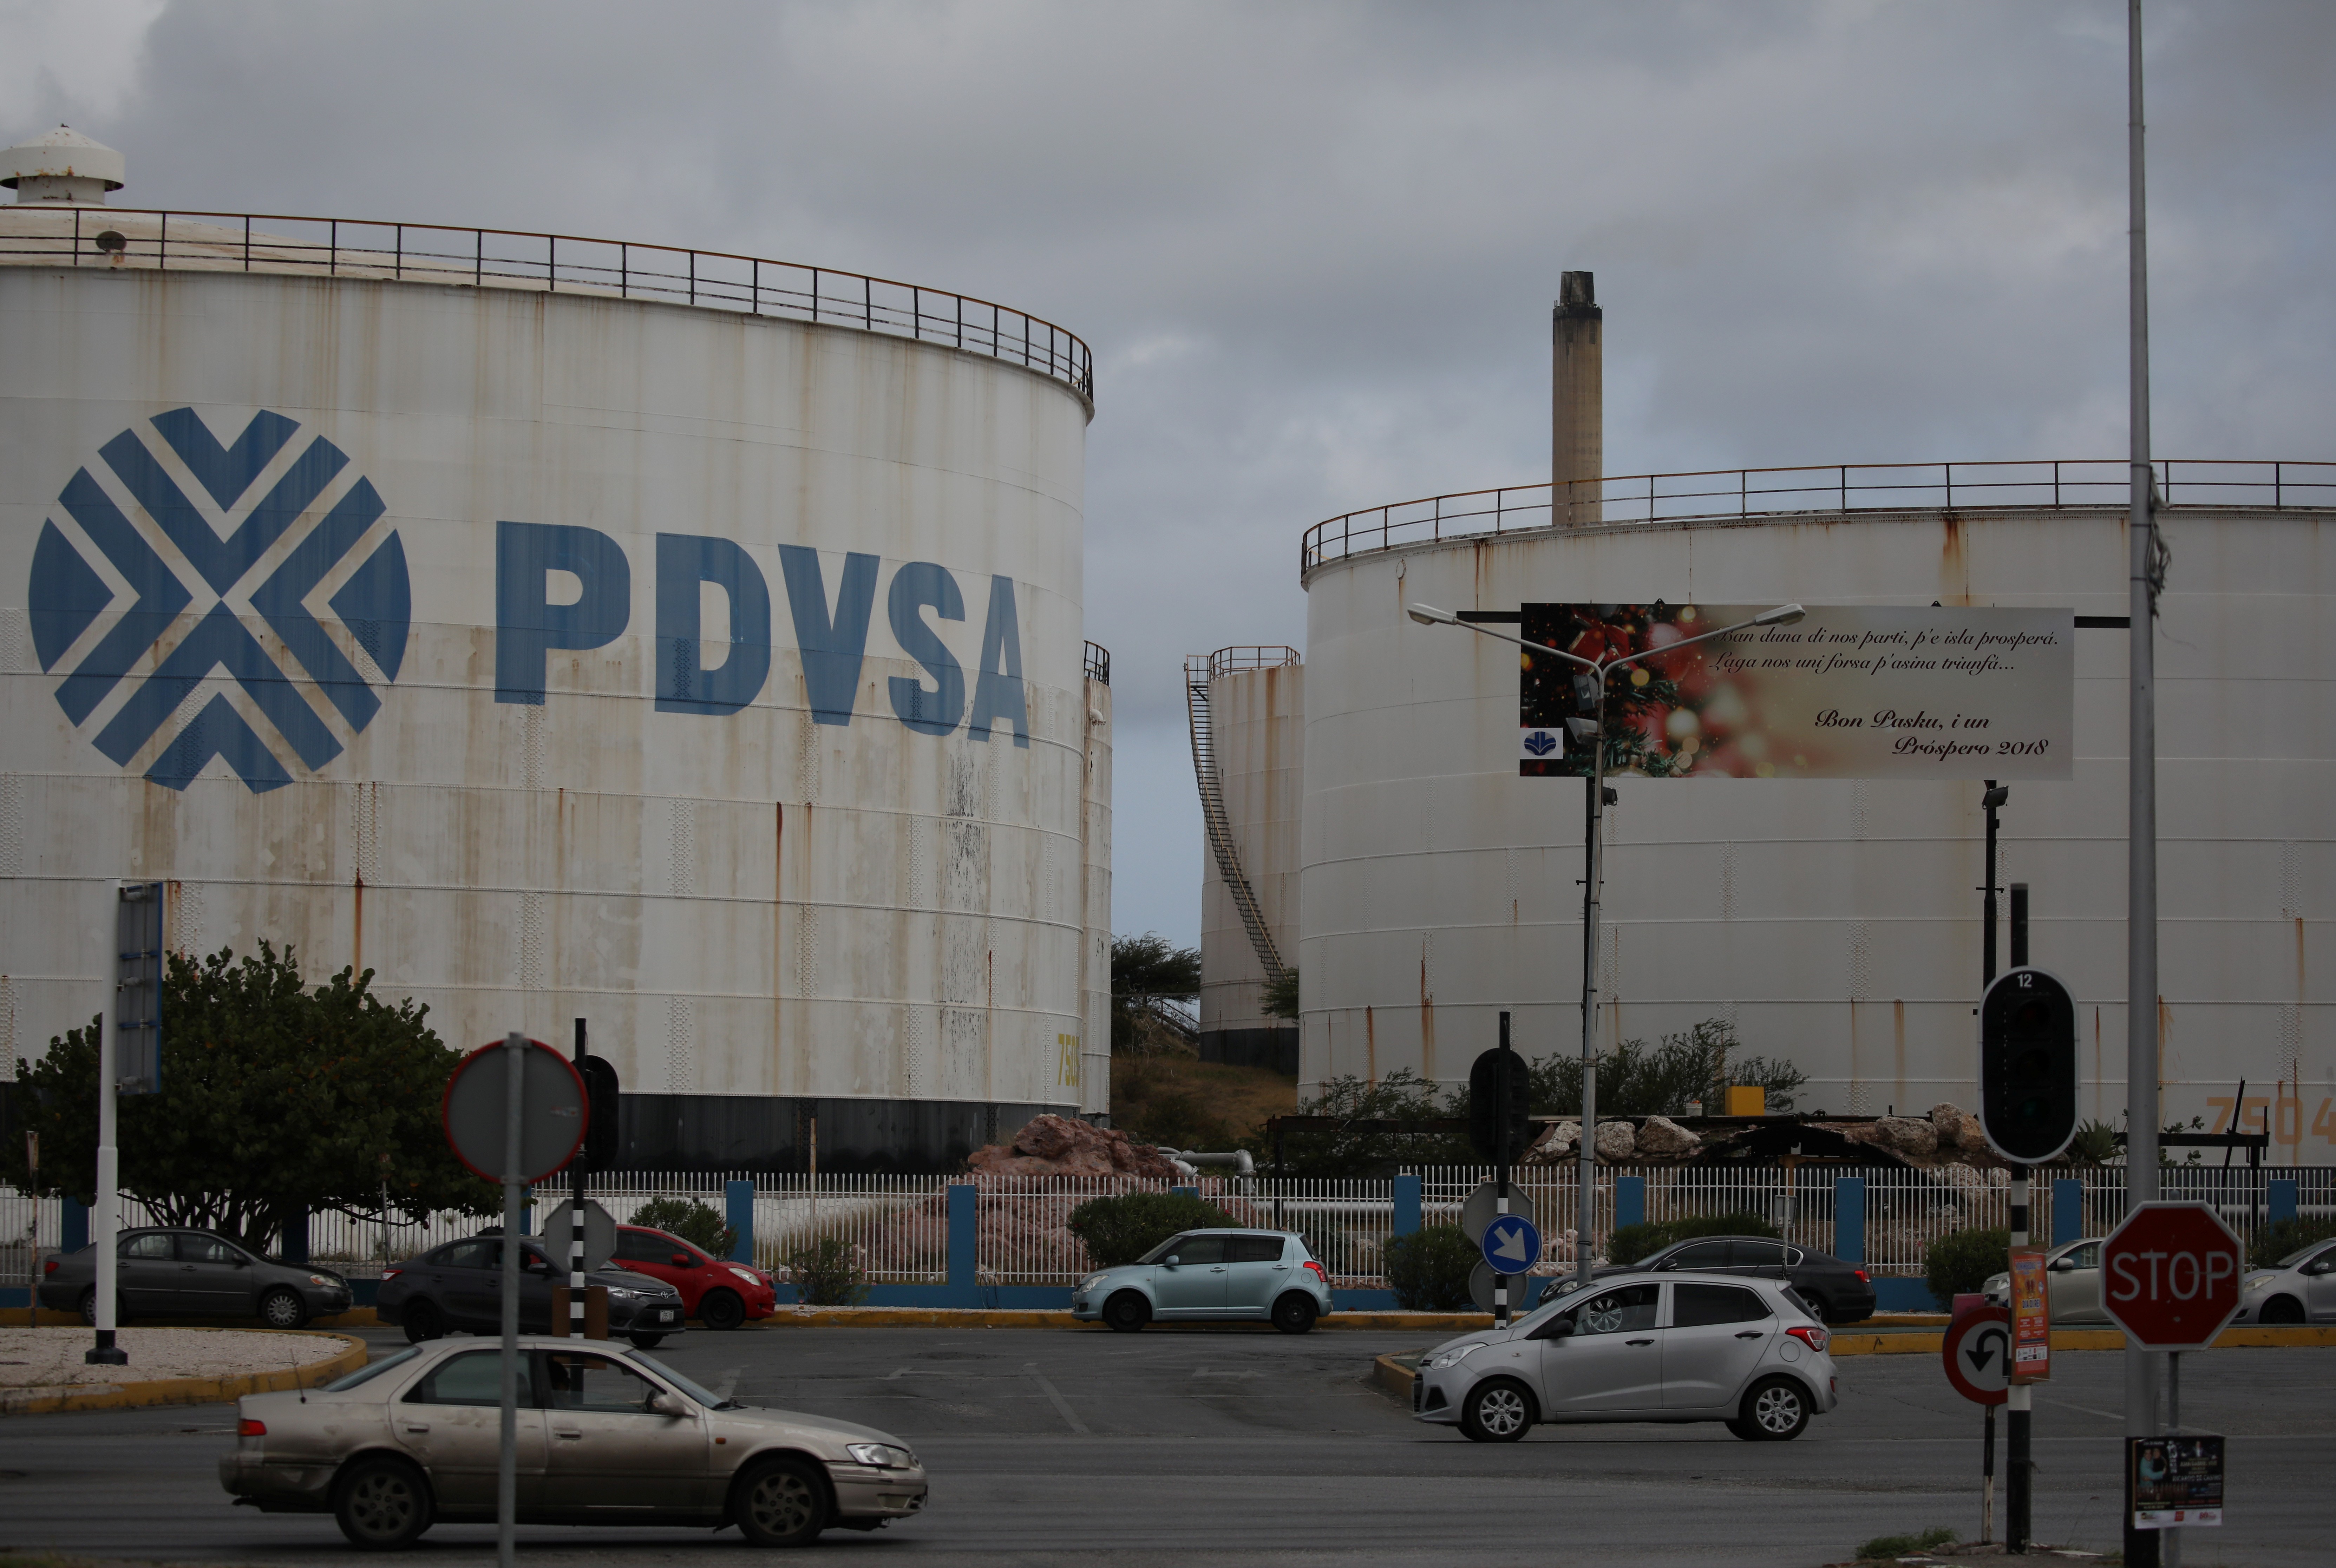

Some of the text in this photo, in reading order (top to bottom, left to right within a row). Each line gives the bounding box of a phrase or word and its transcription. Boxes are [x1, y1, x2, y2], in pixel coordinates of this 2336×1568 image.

[495, 521, 1029, 749] PDVSA
[1760, 627, 1804, 643] duna
[1808, 627, 1827, 643] di
[1828, 634, 1859, 644] nos
[1858, 630, 1908, 650] parti,
[1944, 628, 1975, 645] isla
[1974, 631, 2057, 651] prosperá.
[1709, 651, 1758, 674] Laga
[1761, 658, 1792, 668] nos
[1795, 655, 1826, 668] uni
[1815, 652, 1872, 674] forsa
[1871, 653, 1938, 675] p'asina
[1815, 709, 1992, 731] Bon Pasku, i un
[1892, 736, 2049, 761] Próspero 2018
[2017, 973, 2032, 988] 12
[2206, 1097, 2336, 1145] 7504
[2111, 1249, 2233, 1301] STOP
